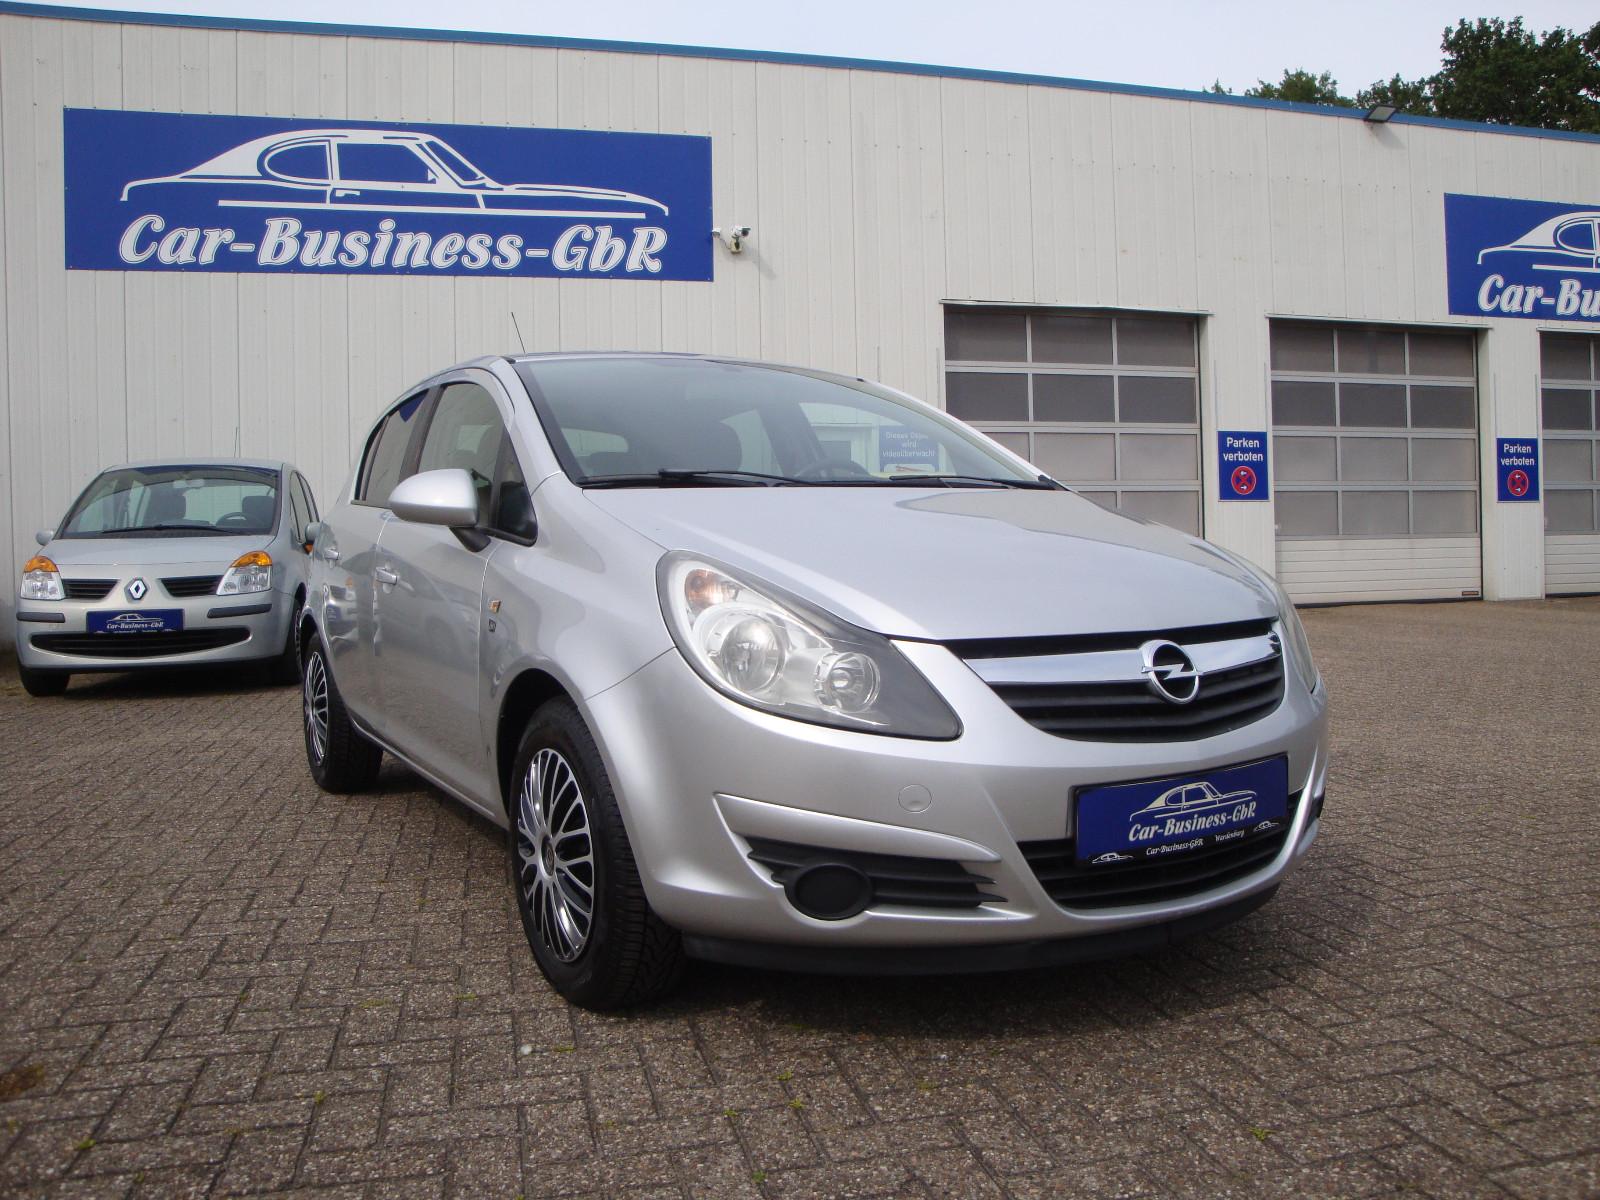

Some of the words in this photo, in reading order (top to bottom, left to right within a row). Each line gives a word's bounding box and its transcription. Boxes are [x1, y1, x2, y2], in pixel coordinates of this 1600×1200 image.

[119, 214, 668, 273] Car-Business-GbR
[1226, 437, 1260, 448] Parken
[1503, 444, 1532, 453] Parken
[1223, 451, 1264, 461] verboten
[1500, 456, 1535, 466] verboten
[1128, 801, 1257, 842] Car-Business-GbR
[1146, 838, 1204, 856] Car-Business-GbR
